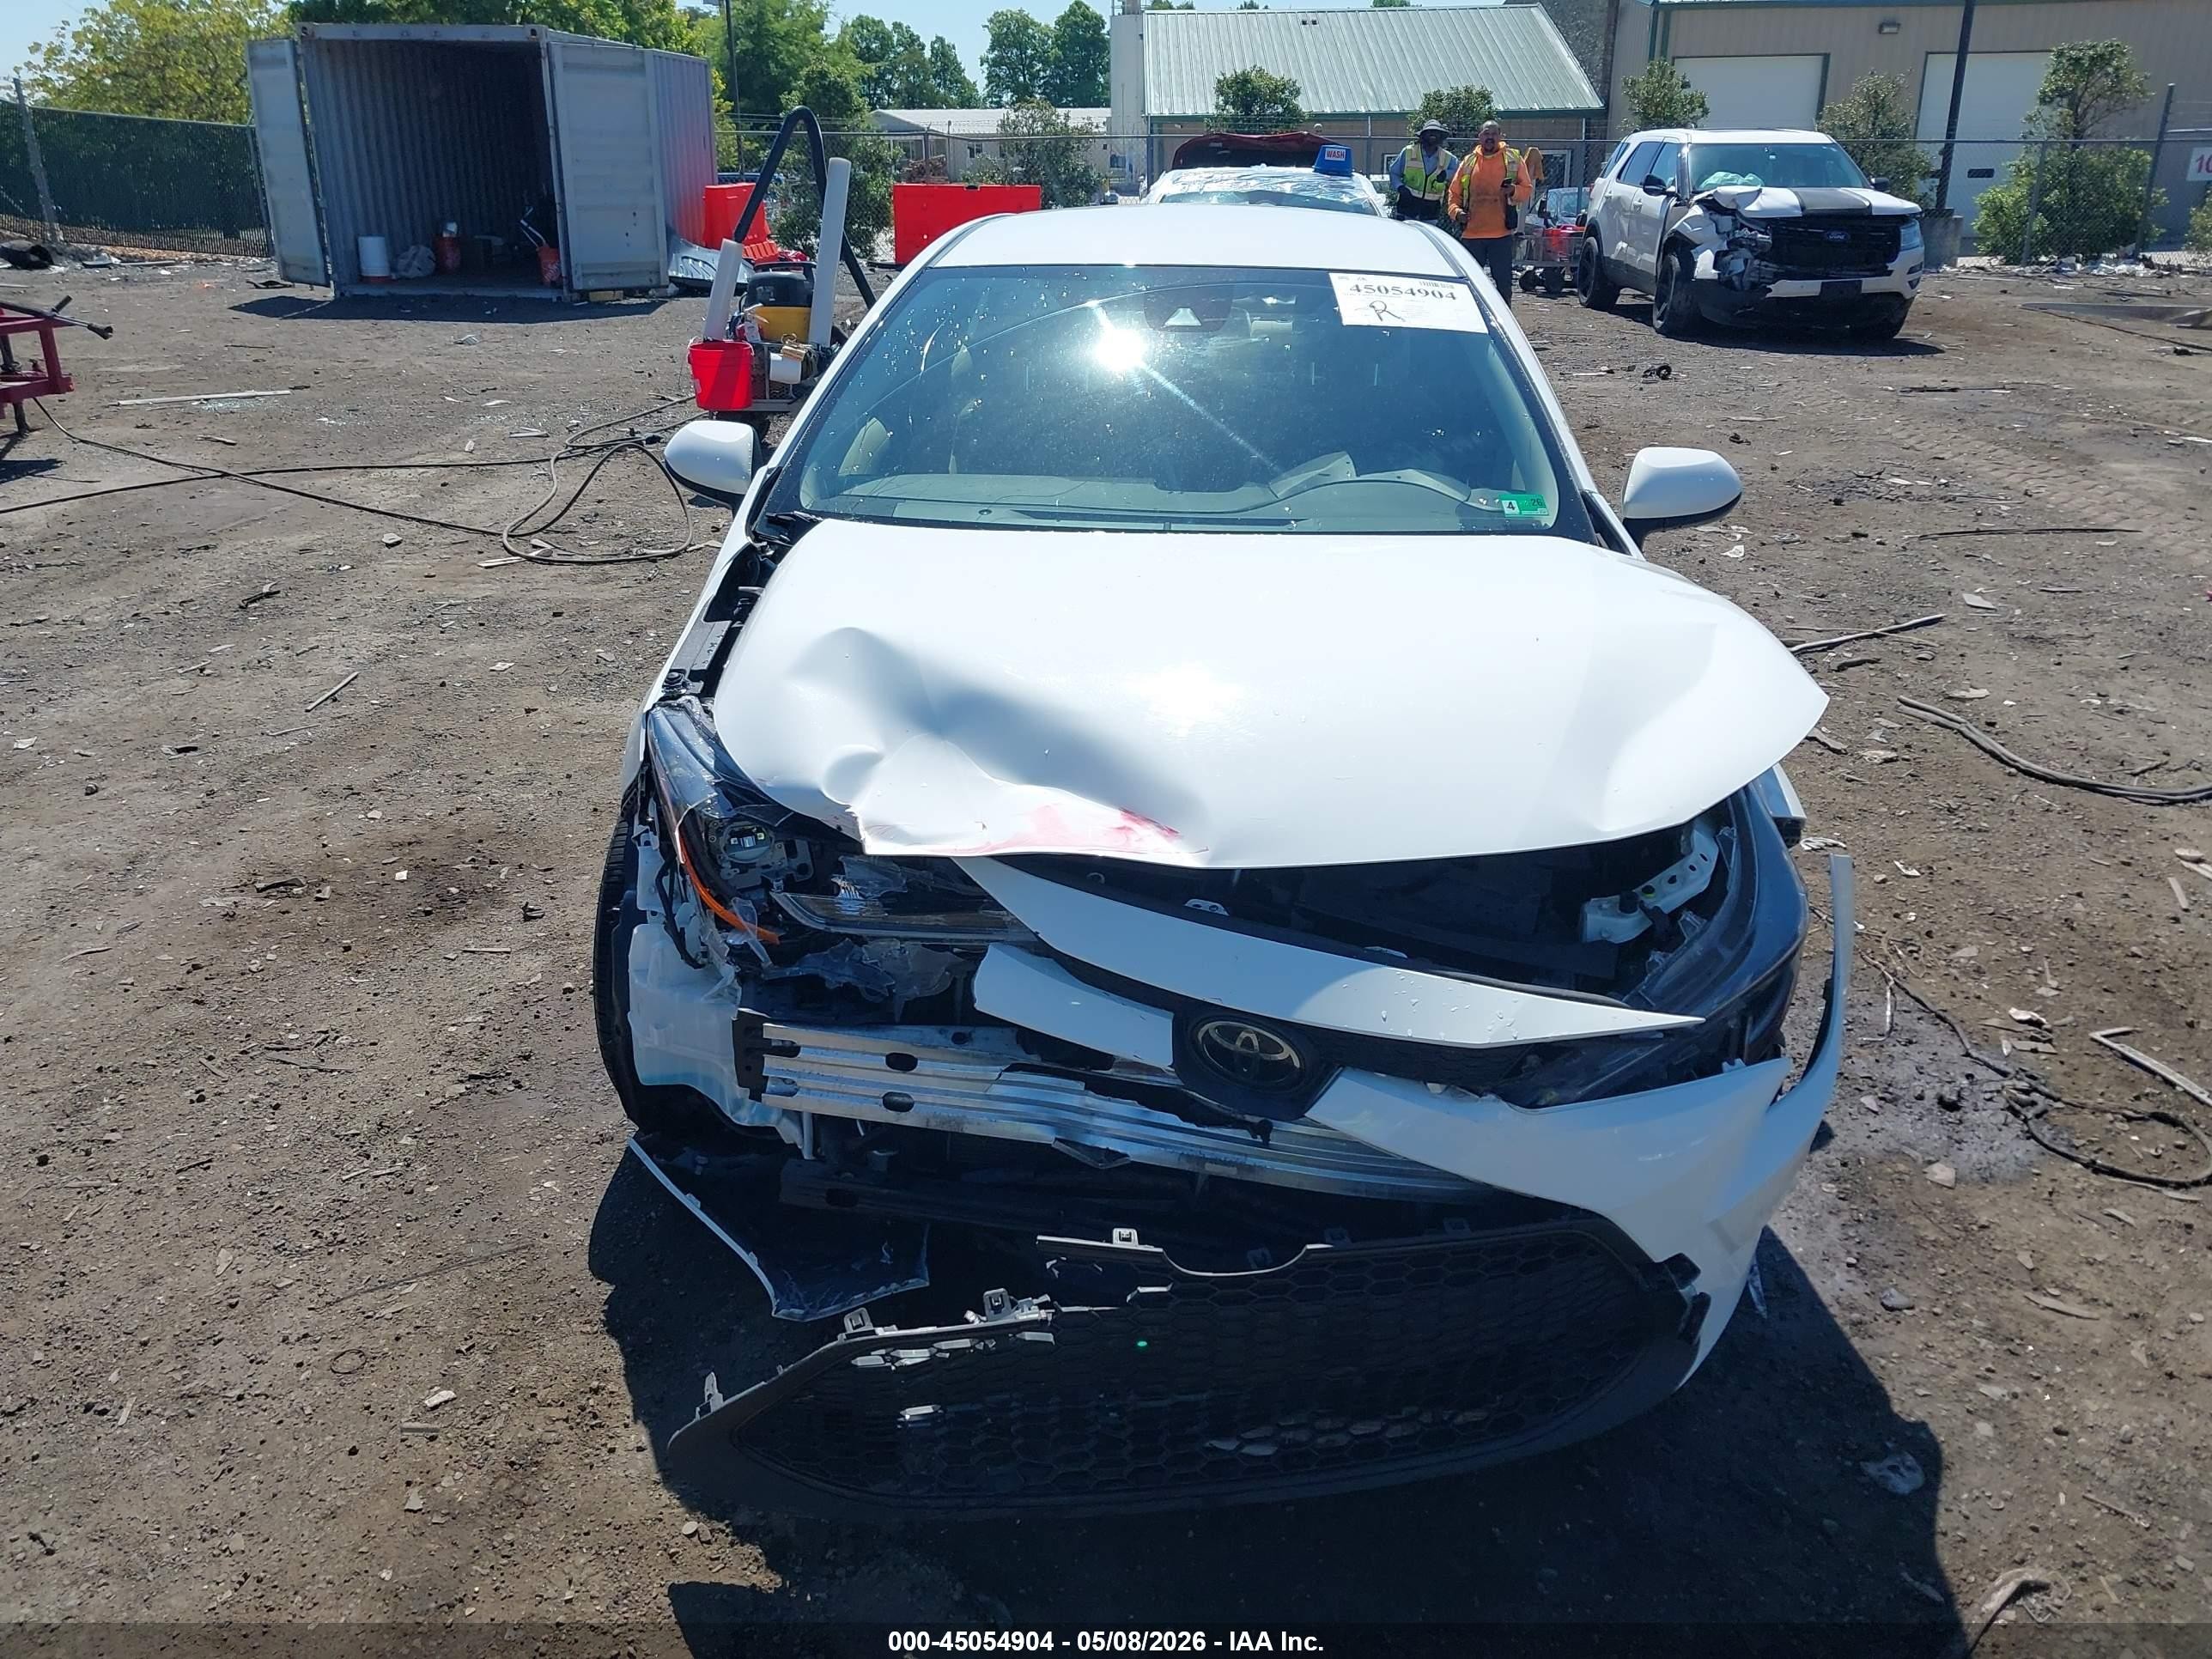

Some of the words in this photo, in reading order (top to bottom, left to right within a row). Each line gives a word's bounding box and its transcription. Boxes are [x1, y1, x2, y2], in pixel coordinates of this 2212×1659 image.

[1327, 150, 1346, 159] WASH
[1349, 283, 1457, 301] 45054904
[1369, 300, 1406, 323] R
[1507, 501, 1516, 511] 4
